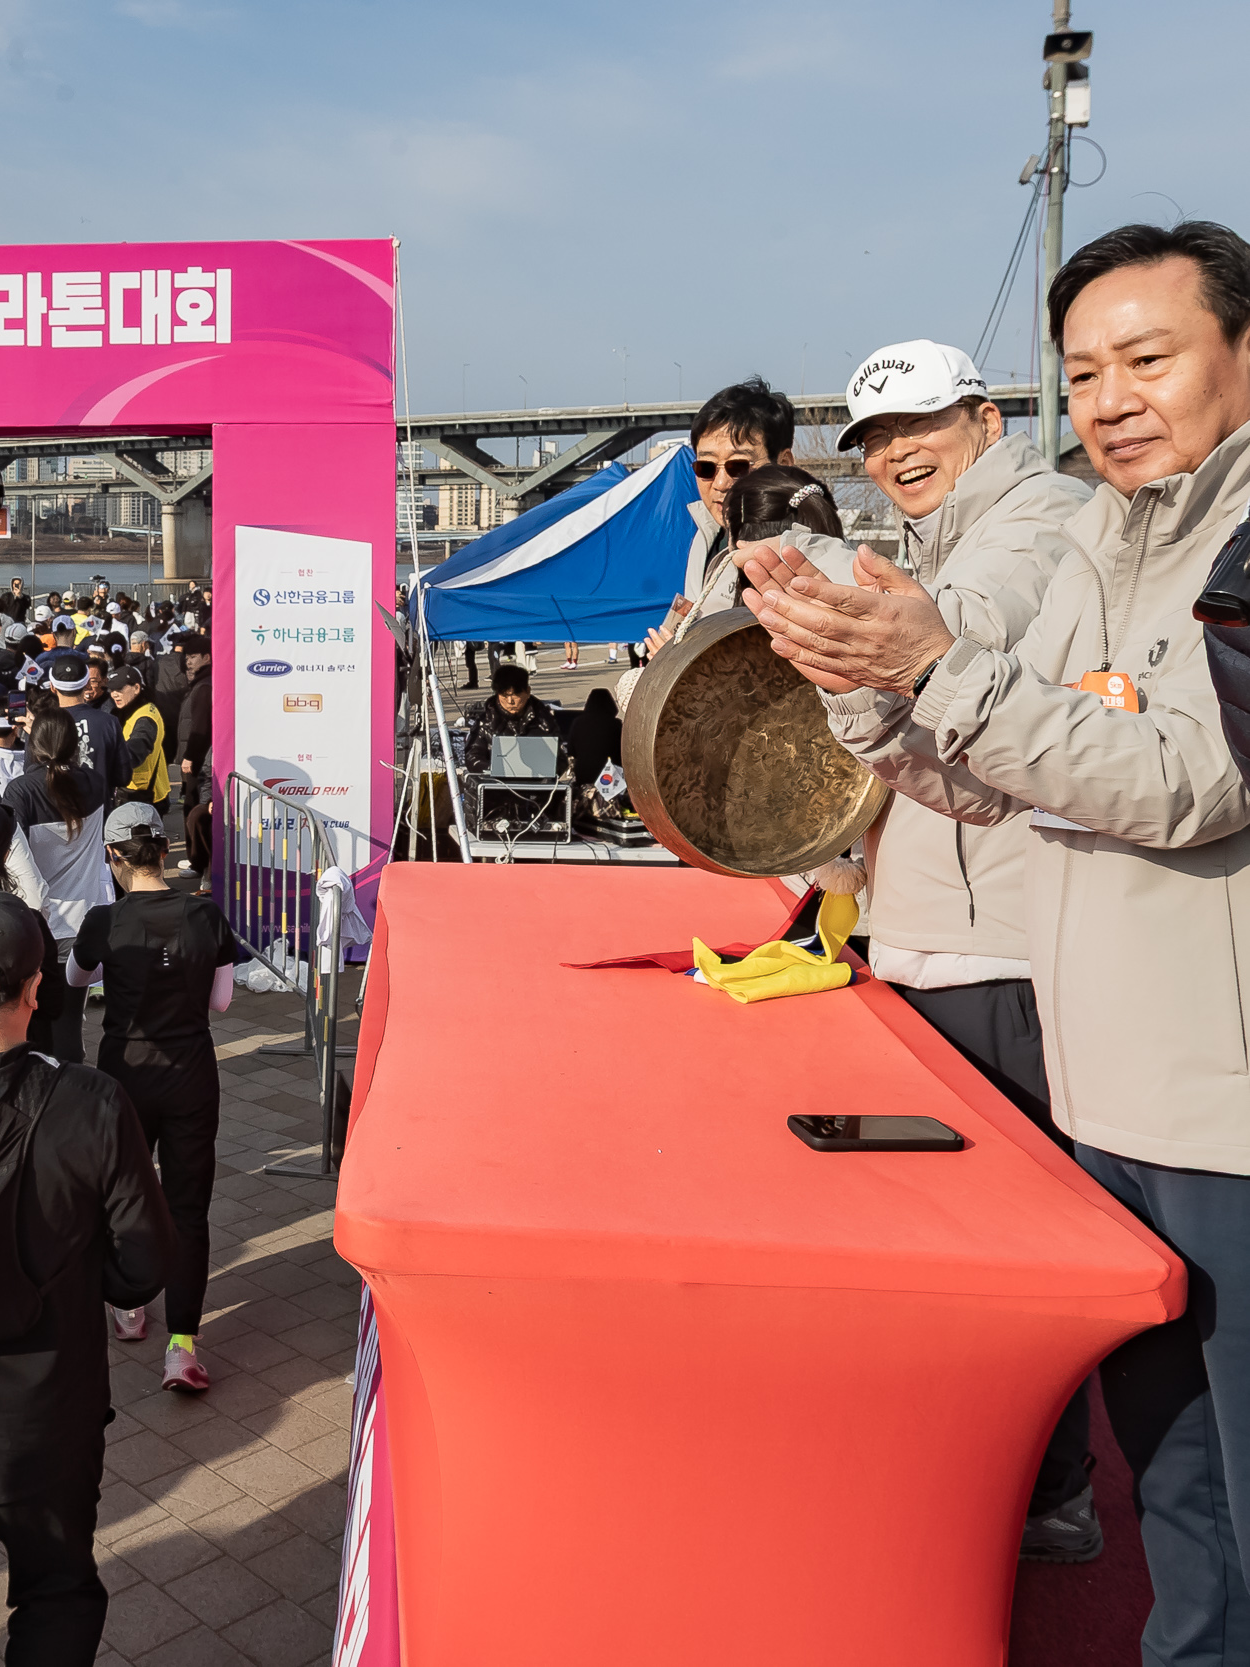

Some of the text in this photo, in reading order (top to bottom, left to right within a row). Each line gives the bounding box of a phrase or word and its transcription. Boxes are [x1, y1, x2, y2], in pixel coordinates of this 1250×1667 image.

[853, 359, 915, 397] Callaway
[297, 568, 314, 577] 협찬
[274, 590, 356, 605] 신한금융그룹
[273, 627, 356, 643] 하나금융그룹
[253, 662, 356, 673] Carrier 에너지 솔루션
[278, 786, 350, 796] WORLD RUN
